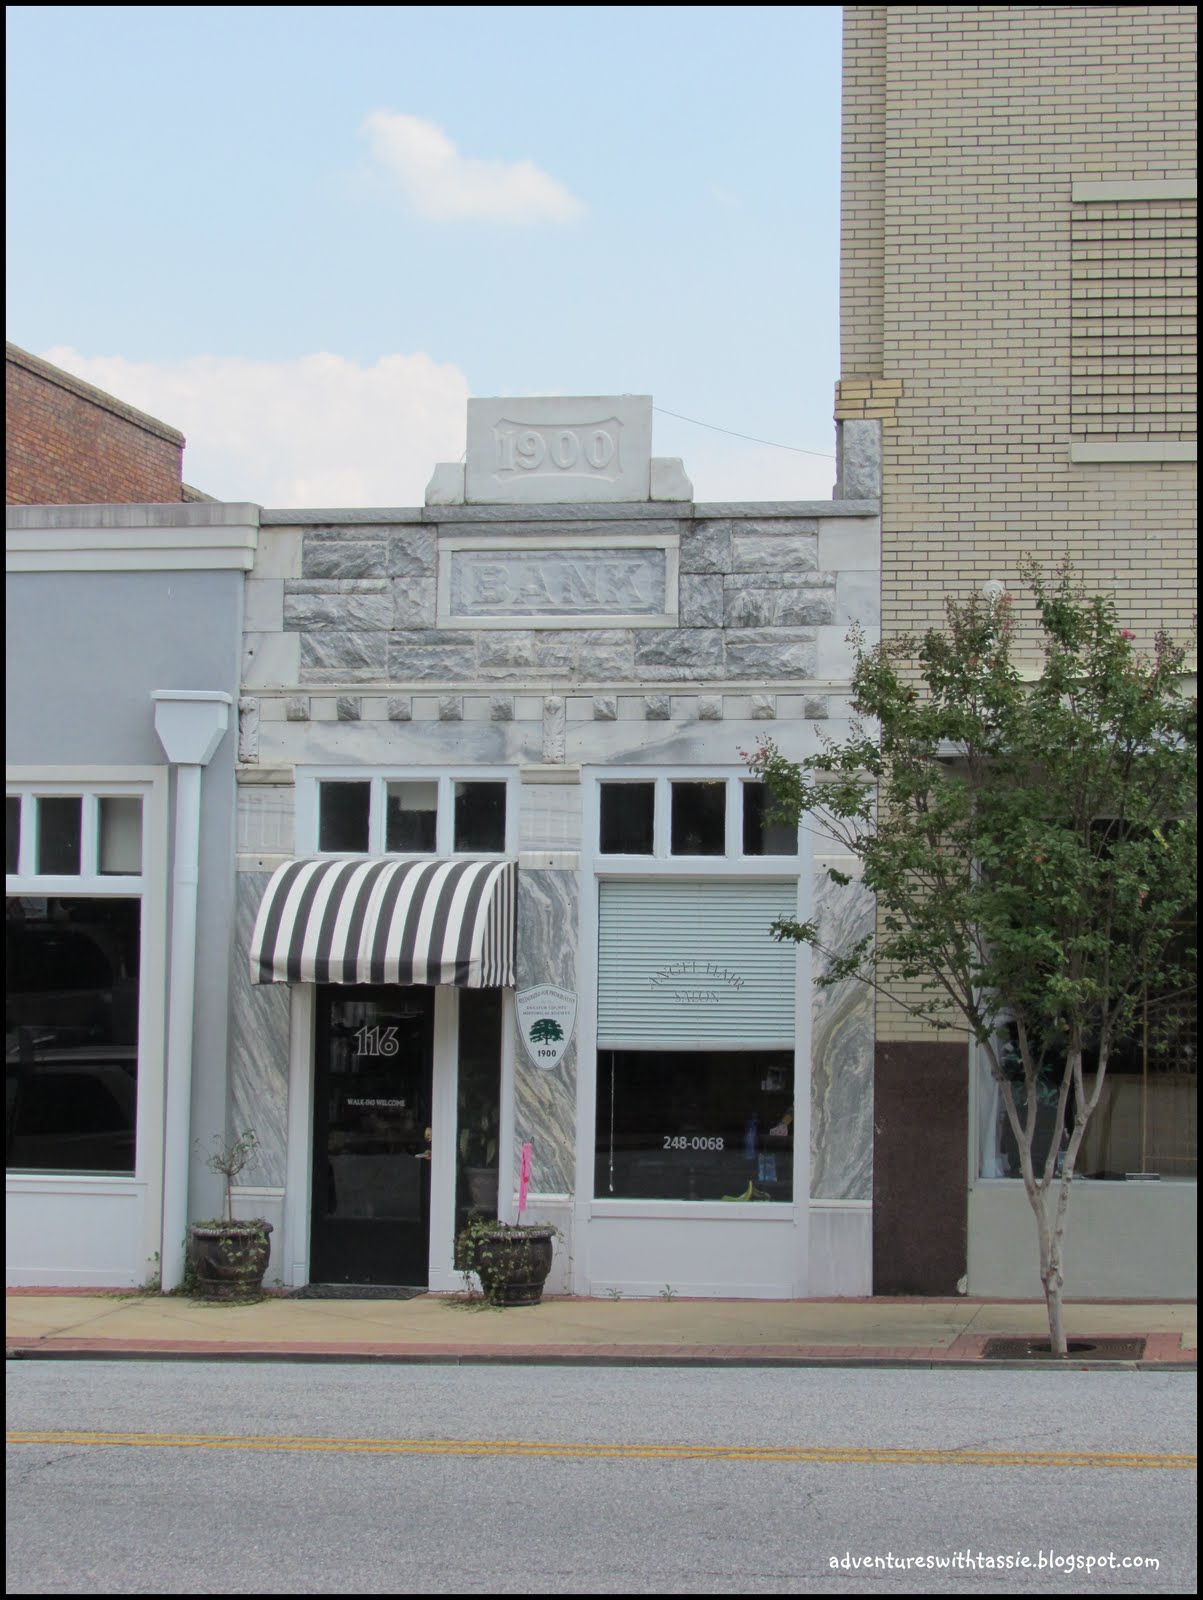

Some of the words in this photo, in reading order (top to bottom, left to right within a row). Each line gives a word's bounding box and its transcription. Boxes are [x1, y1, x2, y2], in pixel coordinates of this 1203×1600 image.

[499, 430, 616, 472] 1900
[468, 562, 645, 605] BANK
[705, 962, 745, 990] HAIR
[674, 990, 720, 1003] SALON
[354, 1025, 399, 1056] 116
[537, 1049, 557, 1058] 1900
[347, 1098, 376, 1106] WALK-INS
[376, 1098, 406, 1107] WELCOME
[662, 1135, 725, 1151] 248-0068
